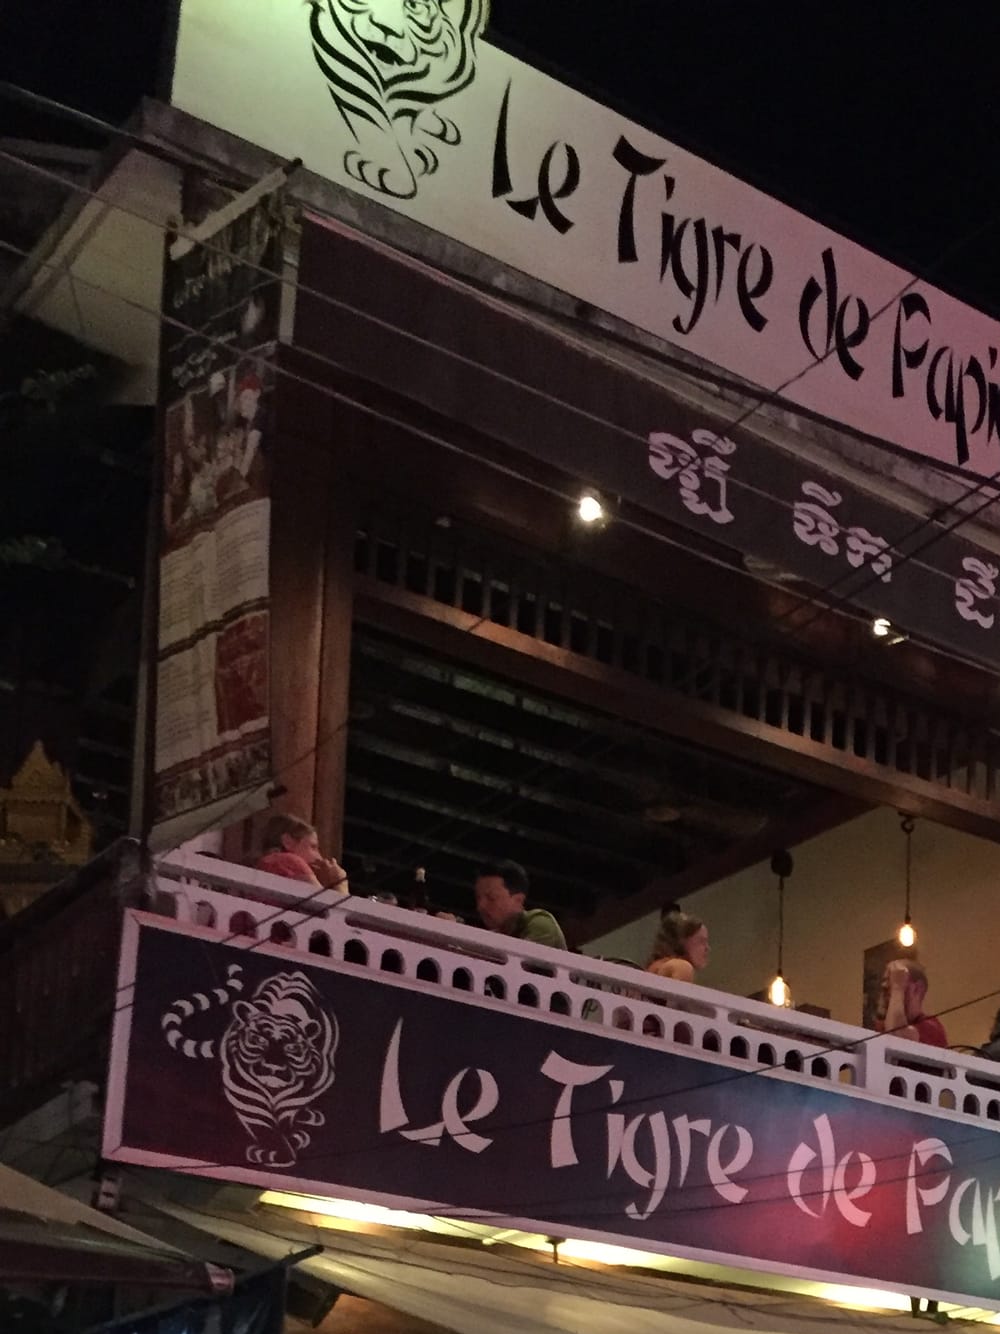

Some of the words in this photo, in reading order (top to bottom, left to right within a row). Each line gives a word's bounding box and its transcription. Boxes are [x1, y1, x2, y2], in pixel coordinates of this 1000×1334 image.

[492, 79, 581, 235] Le
[611, 136, 773, 333] Tigre
[799, 248, 870, 381] de
[380, 1017, 500, 1153] Le
[541, 1050, 754, 1221] Tigre
[787, 1113, 876, 1228] de
